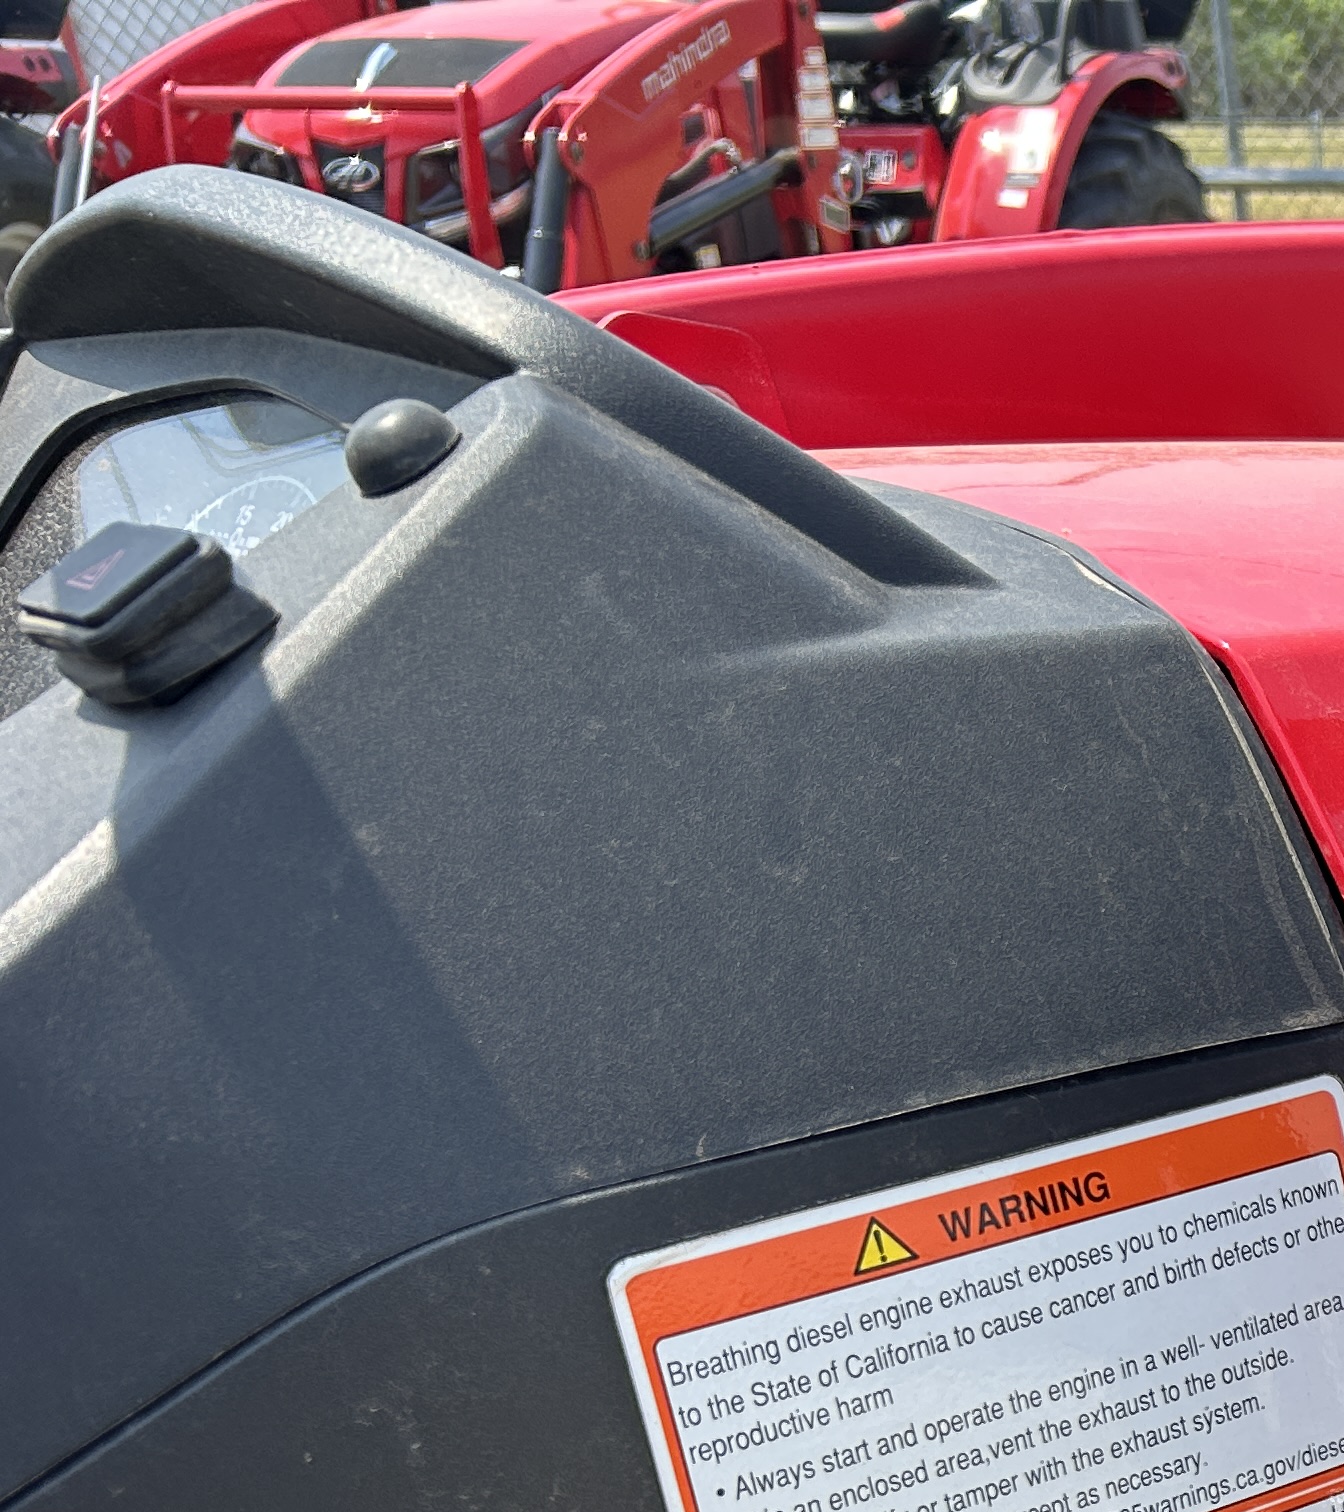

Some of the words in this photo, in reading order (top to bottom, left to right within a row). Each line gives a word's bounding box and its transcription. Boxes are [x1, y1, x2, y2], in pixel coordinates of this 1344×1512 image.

[641, 18, 732, 102] mahindra
[938, 1171, 1110, 1242] WARNING
[666, 1339, 781, 1386] Breathing
[786, 1312, 853, 1353] diesel
[859, 1296, 933, 1332] engine
[939, 1266, 1023, 1308] exhaust
[1028, 1244, 1113, 1283] exposes
[1117, 1231, 1154, 1263] you
[1157, 1224, 1178, 1245] to
[1183, 1193, 1277, 1239] chemicals
[1278, 1178, 1339, 1210] known
[678, 1407, 701, 1428] to
[707, 1394, 745, 1420] the
[750, 1374, 811, 1407] State
[818, 1360, 839, 1387] of
[845, 1331, 951, 1379] California
[953, 1326, 975, 1347] to
[981, 1306, 1043, 1339] cause
[1049, 1283, 1115, 1319] cancer
[1122, 1265, 1160, 1297] and
[1162, 1254, 1207, 1284] birth
[1211, 1235, 1279, 1270] defects
[1283, 1228, 1301, 1249] or
[688, 1407, 830, 1464] reproductive
[834, 1388, 894, 1420] harm
[736, 1460, 815, 1500] Always
[821, 1439, 872, 1473] start
[877, 1422, 918, 1456] and
[924, 1402, 1004, 1443] operate
[1008, 1389, 1042, 1414] the
[1048, 1366, 1115, 1401] engine
[1118, 1357, 1139, 1379] in
[1143, 1354, 1158, 1372] a
[1160, 1334, 1205, 1366] well-
[1209, 1302, 1299, 1350] ventilated
[829, 1459, 929, 1511] enclosed
[935, 1427, 1036, 1477] area,vent
[1038, 1419, 1072, 1444] the
[1078, 1388, 1158, 1431] exhaust
[1160, 1384, 1180, 1404] to
[1184, 1372, 1216, 1397] the
[1221, 1346, 1294, 1385] outside.
[1024, 1456, 1067, 1487] with
[1071, 1447, 1104, 1472] the
[1110, 1416, 1189, 1459] exhaust
[1192, 1396, 1265, 1435] system.
[1076, 1487, 1100, 1509] as
[1105, 1451, 1208, 1499] necessary.
